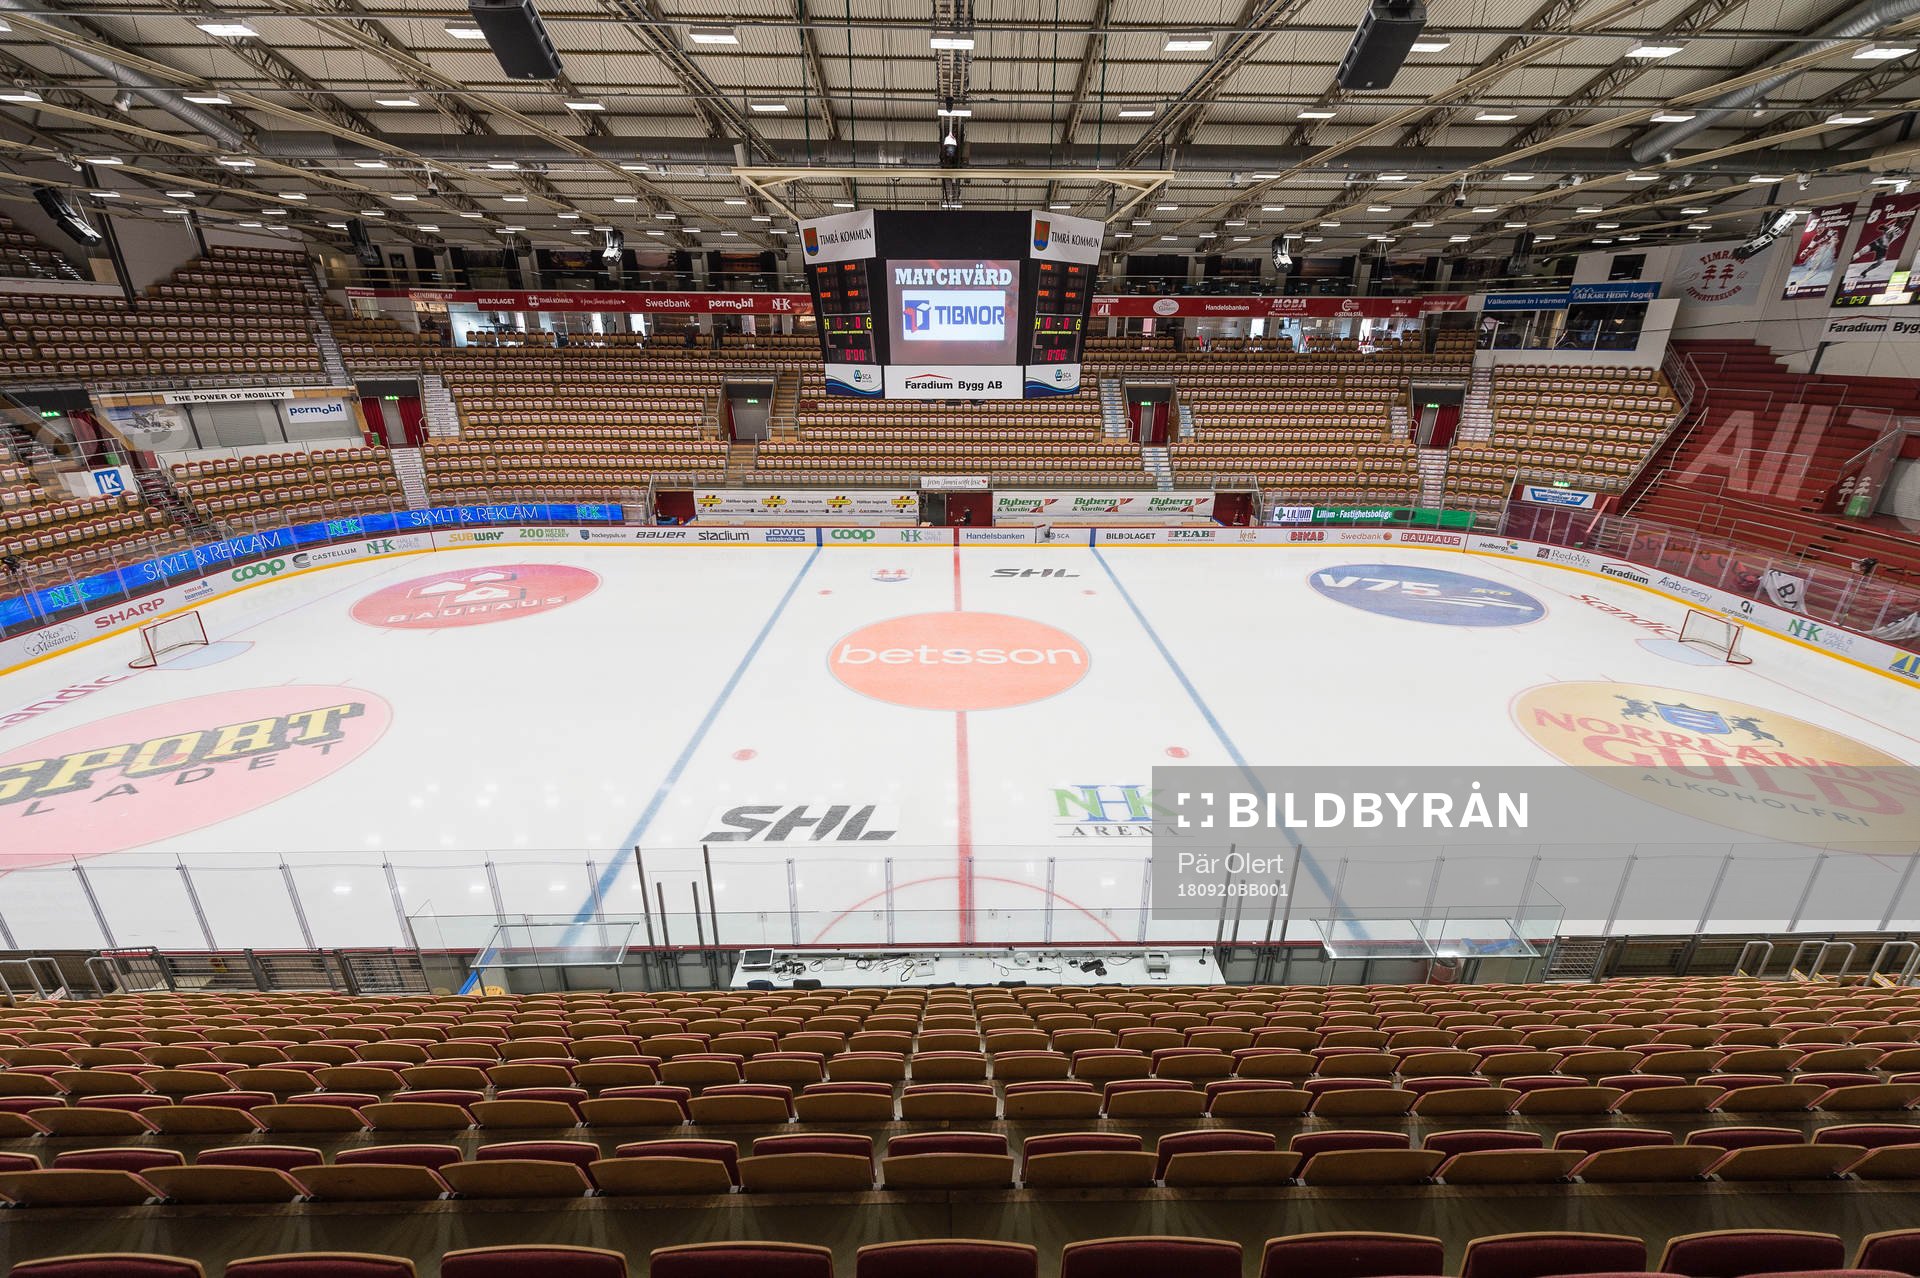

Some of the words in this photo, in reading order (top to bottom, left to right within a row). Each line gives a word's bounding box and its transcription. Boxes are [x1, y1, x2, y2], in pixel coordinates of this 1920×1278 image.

[1867, 209, 1881, 223] 8
[819, 232, 839, 245] TIMRÅ
[840, 228, 872, 242] KOMMUN
[1051, 231, 1070, 245] TIMRÅ
[1072, 234, 1099, 248] KOMMUN
[895, 264, 1012, 286] MATCHVÄRD
[645, 299, 690, 308] Swedbank
[708, 298, 754, 310] permobil
[934, 305, 1005, 325] TIBNOR
[824, 319, 830, 329] H
[866, 317, 872, 329] G
[1035, 318, 1041, 329] H
[1076, 319, 1081, 330] G
[1828, 322, 1886, 332] Faradium
[1893, 322, 1920, 334] Byg
[904, 380, 953, 389] Faradium
[958, 380, 984, 391] Bygg
[987, 381, 1002, 389] AB
[244, 391, 285, 399] MOBILITY
[290, 403, 343, 417] permobil
[999, 498, 1042, 508] Byberg
[1075, 498, 1117, 507] Byberg
[1150, 498, 1193, 507] Byberg
[410, 508, 454, 526] SKYLT
[461, 509, 473, 520] &
[477, 506, 538, 520] REKLAM
[1286, 510, 1311, 519] LILIUM
[449, 532, 504, 542] SUBWAY
[698, 529, 749, 541] stadium
[831, 529, 875, 541] coop
[901, 530, 922, 542] NHK
[966, 532, 1025, 540] Handelsbanken
[1290, 532, 1324, 541] BEKAB
[1401, 533, 1460, 545] BAUHAUS
[366, 539, 395, 554] NHK
[1479, 542, 1508, 551] Hellbergs
[144, 553, 190, 580] SKYLT
[195, 550, 208, 566] &
[209, 532, 280, 560] REKLAM
[312, 548, 356, 561] CASTELLUM
[232, 559, 285, 582] coop
[990, 568, 1080, 578] SHL
[1601, 565, 1649, 584] Faradium
[1318, 573, 1441, 596] V75
[94, 598, 165, 629] SHARP
[386, 596, 567, 624] BAUHAUS
[1579, 594, 1680, 636] Scandic
[1787, 619, 1823, 641] NHK
[838, 644, 1081, 665] betsson
[0, 674, 123, 731] andic
[0, 702, 365, 804] SPORT
[1532, 708, 1920, 796] NORRLANDS
[21, 740, 343, 817] LADET
[1583, 736, 1905, 816] GULD
[1049, 784, 1179, 823] NHK
[1641, 774, 1871, 827] ALKOHOLFRI
[699, 805, 898, 842] SHL
[1072, 824, 1179, 838] ARENA
